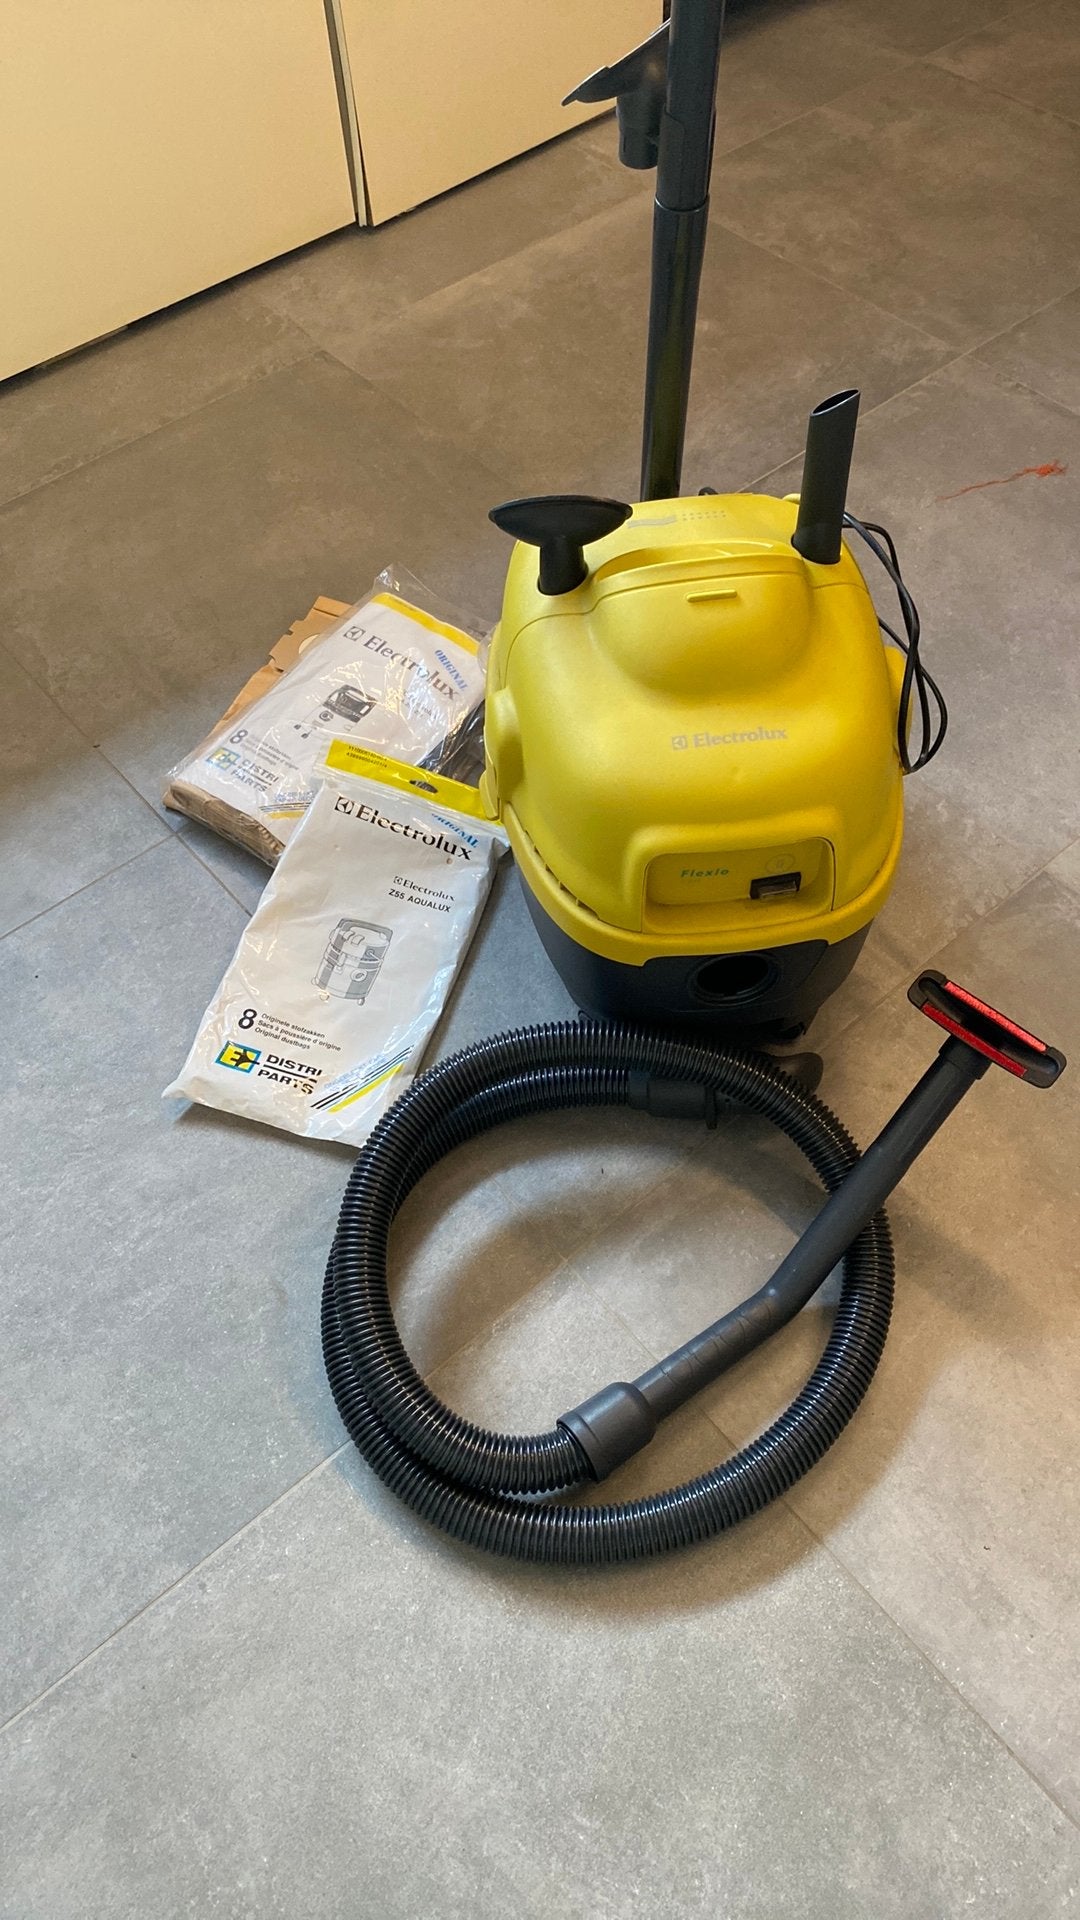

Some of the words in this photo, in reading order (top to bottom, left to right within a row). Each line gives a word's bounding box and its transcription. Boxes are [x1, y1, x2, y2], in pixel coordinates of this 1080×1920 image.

[363, 635, 459, 700] Electrolux
[434, 649, 468, 691] ORIGINAL
[229, 729, 248, 744] 8
[692, 726, 788, 748] Electrolux
[355, 804, 472, 861] Electrolux
[388, 888, 405, 900] Z55
[407, 895, 451, 913] AQUALUX
[402, 879, 455, 902] Electrolux
[238, 1008, 258, 1030] 8
[257, 1019, 274, 1031] Sacs
[261, 1013, 290, 1029] Originele
[254, 1027, 281, 1042] Original
[281, 1036, 311, 1050] dustbags
[266, 1054, 323, 1077] DISTRI
[257, 1069, 315, 1095] PARTS
